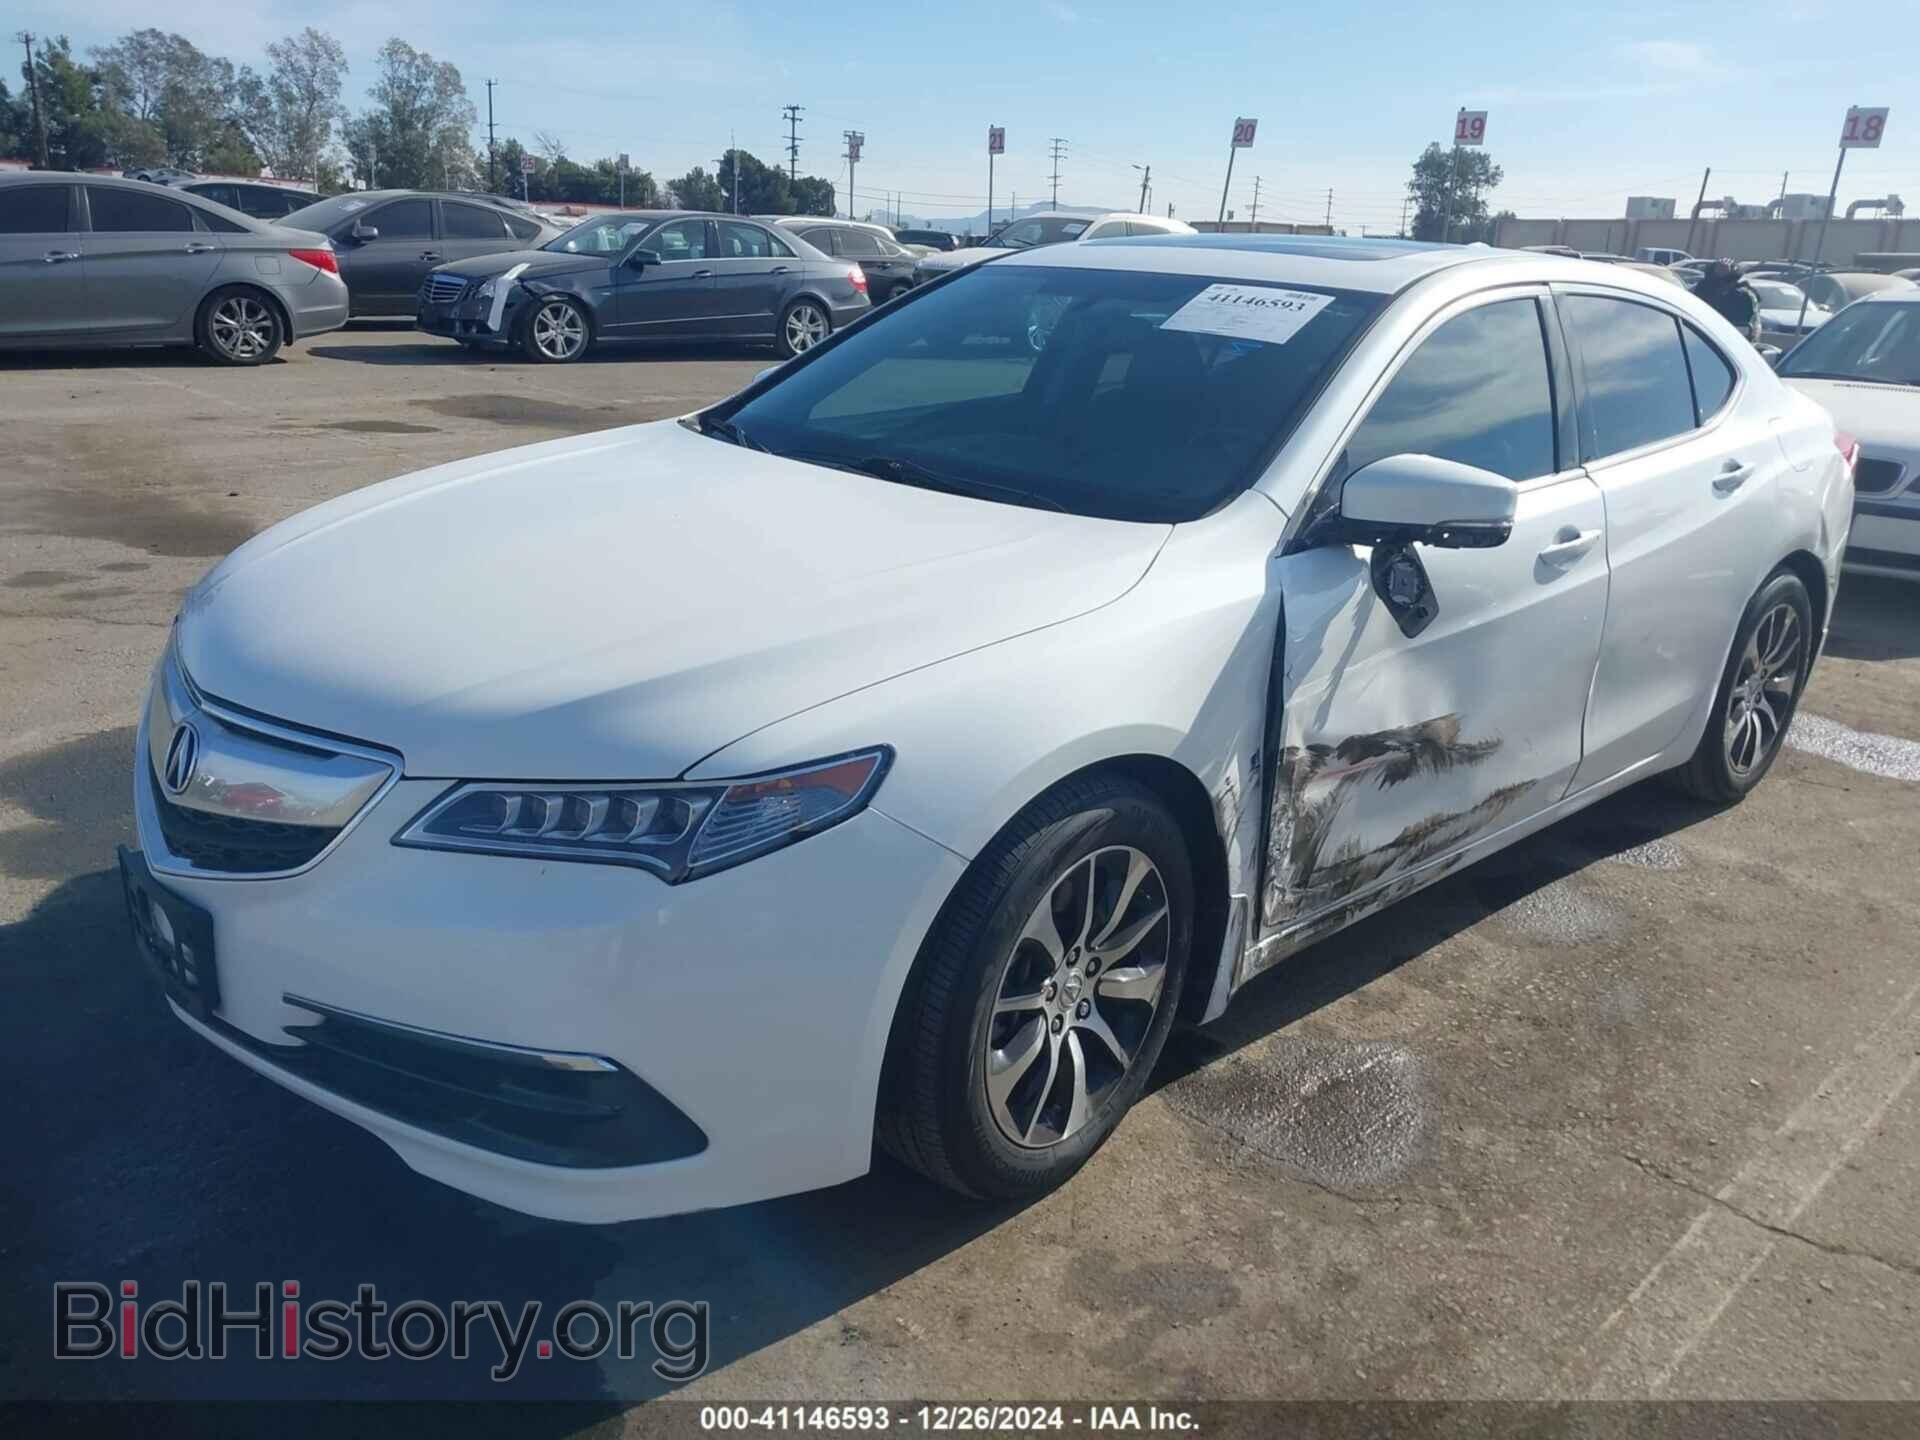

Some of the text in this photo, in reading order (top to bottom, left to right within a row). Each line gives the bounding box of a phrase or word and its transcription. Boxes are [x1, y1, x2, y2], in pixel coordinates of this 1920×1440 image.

[1233, 123, 1255, 143] 20
[1456, 117, 1485, 139] 19
[1843, 115, 1883, 141] 18
[990, 133, 1004, 150] 21
[1208, 293, 1306, 312] 41146593
